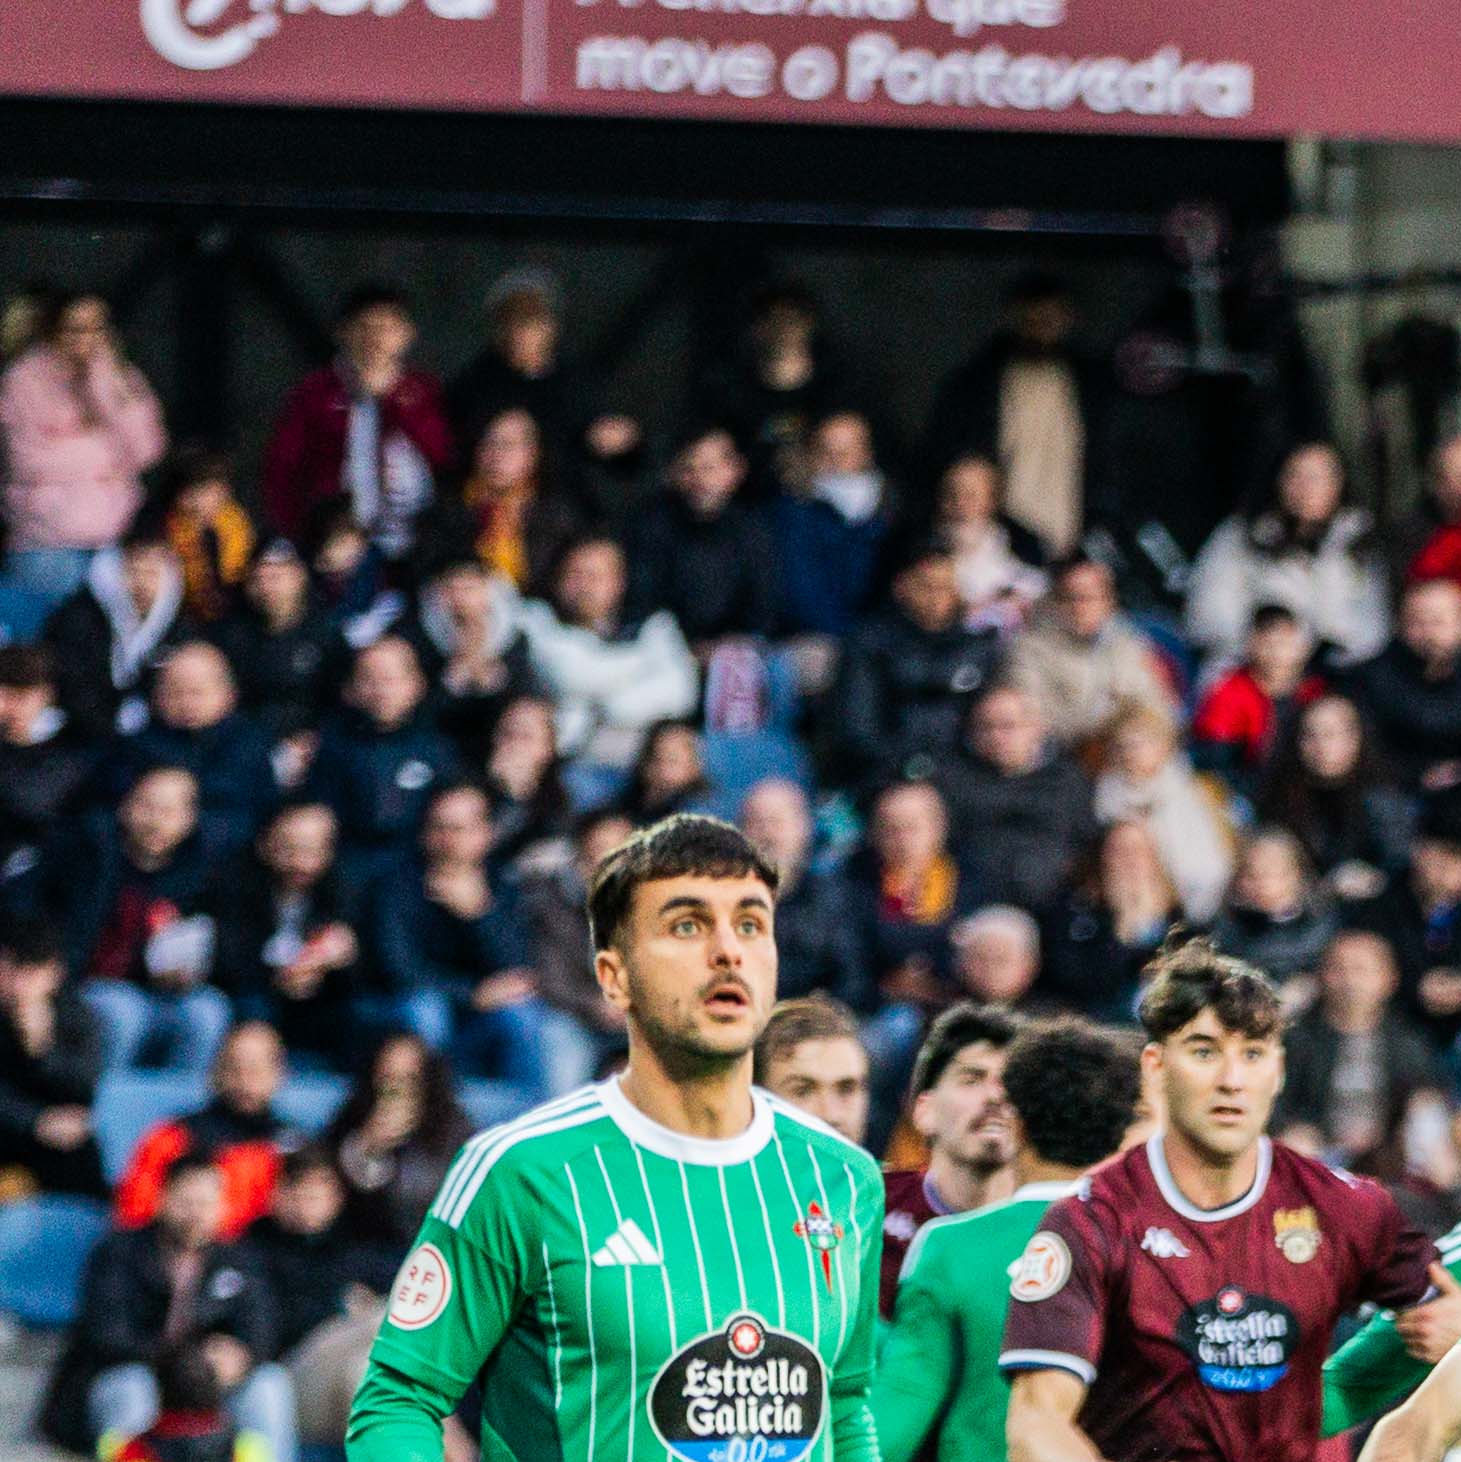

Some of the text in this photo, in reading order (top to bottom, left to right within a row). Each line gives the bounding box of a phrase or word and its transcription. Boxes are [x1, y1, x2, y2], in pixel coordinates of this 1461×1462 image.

[575, 34, 776, 100] move
[845, 30, 1254, 118] Pontevedra
[682, 1357, 808, 1398] Estrella
[686, 1395, 802, 1436] Galicia
